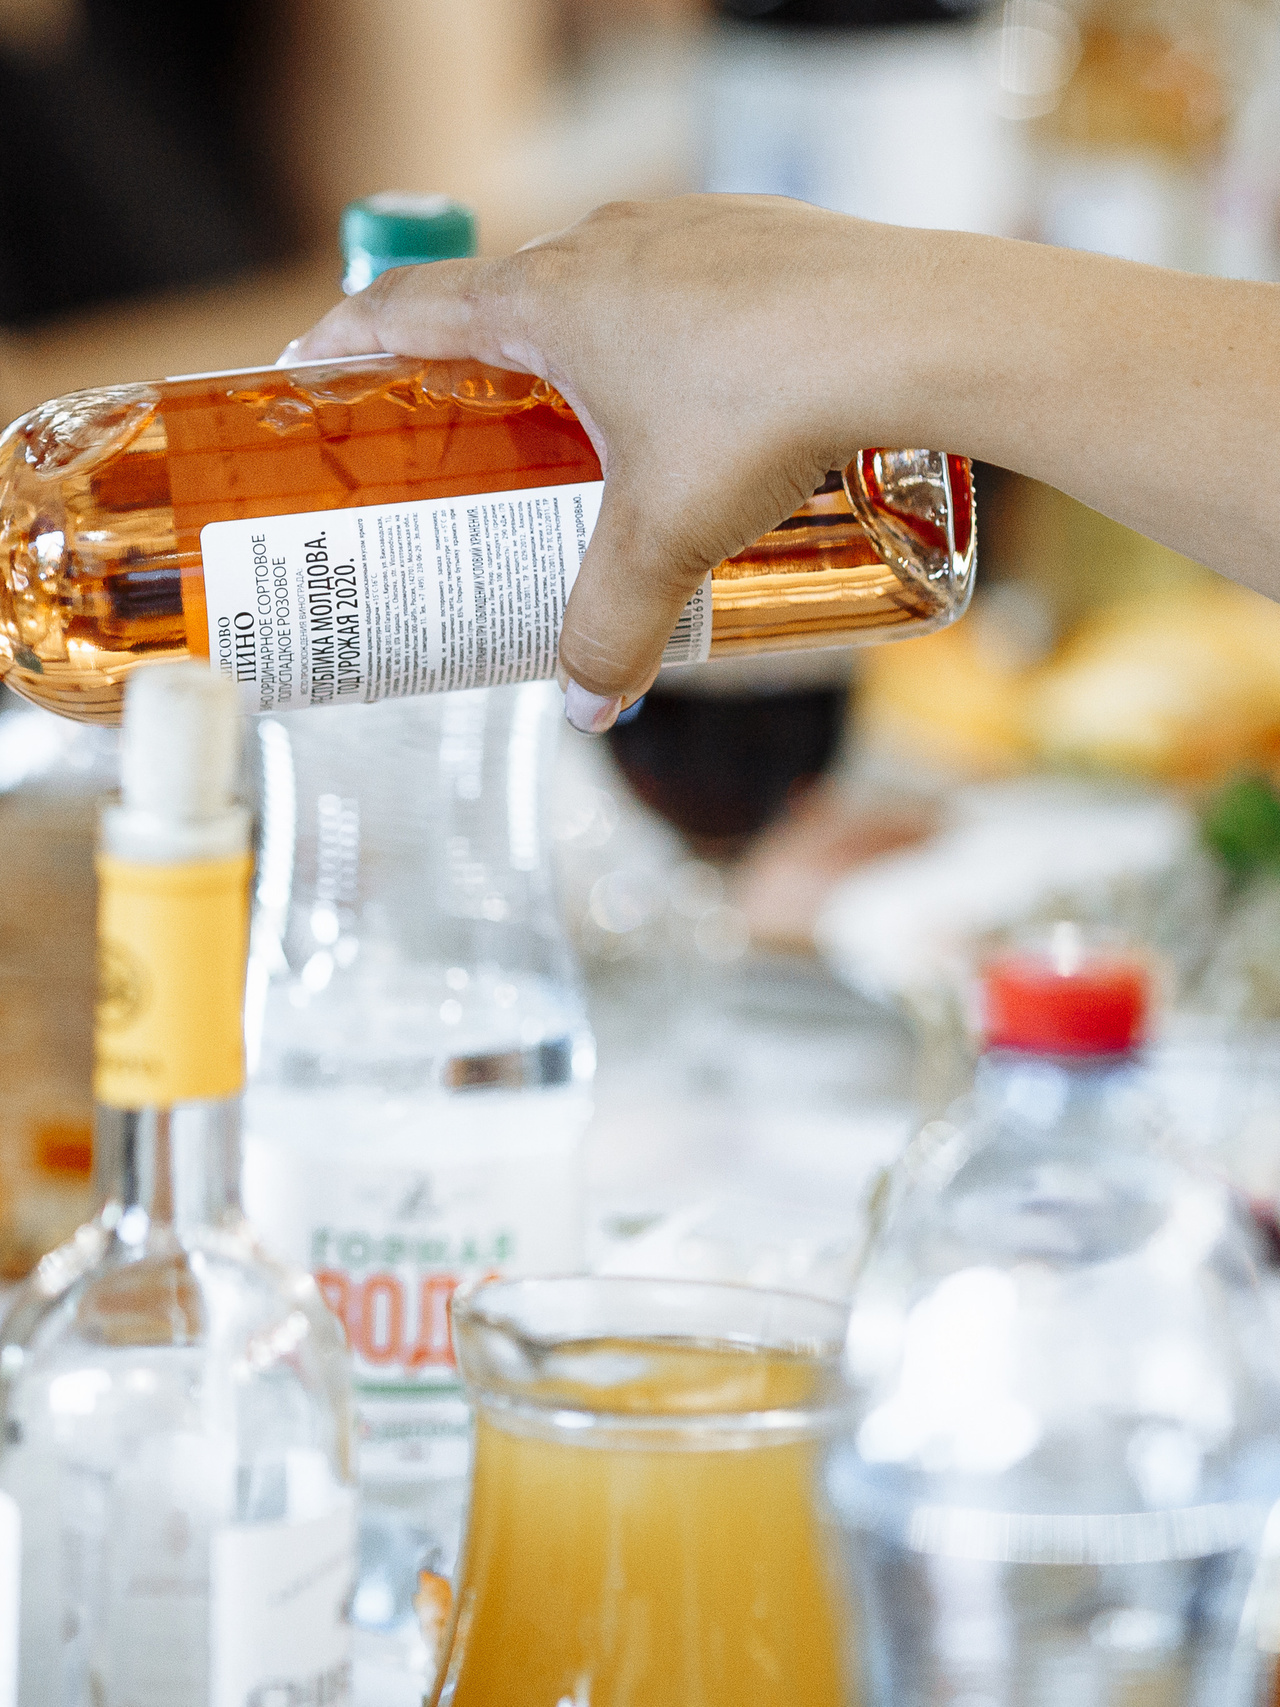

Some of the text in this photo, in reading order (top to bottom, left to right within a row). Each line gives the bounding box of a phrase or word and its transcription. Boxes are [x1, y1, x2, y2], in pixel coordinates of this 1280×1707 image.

[467, 506, 482, 545] ХРАНЕНИЯ.
[481, 505, 490, 538] консервант
[490, 504, 499, 530] (средние
[508, 502, 517, 536] превышает
[517, 501, 525, 528] Алкоголь
[526, 500, 534, 534] женщинам,
[535, 499, 543, 519] других
[552, 497, 561, 531] Республики
[573, 494, 586, 537] ЗДОРОВЬЮ.
[358, 518, 366, 538] яркого
[395, 524, 405, 567] изготовителем
[405, 529, 413, 562] Московская
[432, 510, 441, 550] помещениях,
[451, 522, 459, 546] хранить
[493, 533, 502, 559] продукта
[444, 545, 452, 581] температуре
[453, 549, 461, 573] бутылку
[470, 547, 485, 579] УСЛОВИЙ
[485, 540, 493, 568] содержит
[496, 562, 502, 570] мл
[502, 546, 513, 589] (калорийность)
[529, 536, 538, 567] кормящим
[556, 532, 565, 575] Правительства
[251, 534, 272, 615] СОРТОВОЕ
[417, 576, 426, 590] (495)
[295, 568, 307, 619] ВИНОГРАДА:
[400, 570, 409, 616] уполномоченная
[438, 581, 446, 617] постороннего
[474, 581, 488, 623] СОБЛЮДЕНИИ
[272, 557, 294, 702] ПОЛУСЛАДКОЕ РОЗОВОЕ
[304, 530, 335, 705] РЕСПУБЛИКА МОЛДОВА.
[334, 558, 364, 695] ГОД УРОЖАЯ 2020.
[234, 611, 257, 682] ПИНО
[259, 617, 276, 695] ОРДИНАРНОЕ
[299, 621, 309, 679] ПРОИСХОЖДЕНИЯ
[315, 1268, 498, 1372] ВОД
